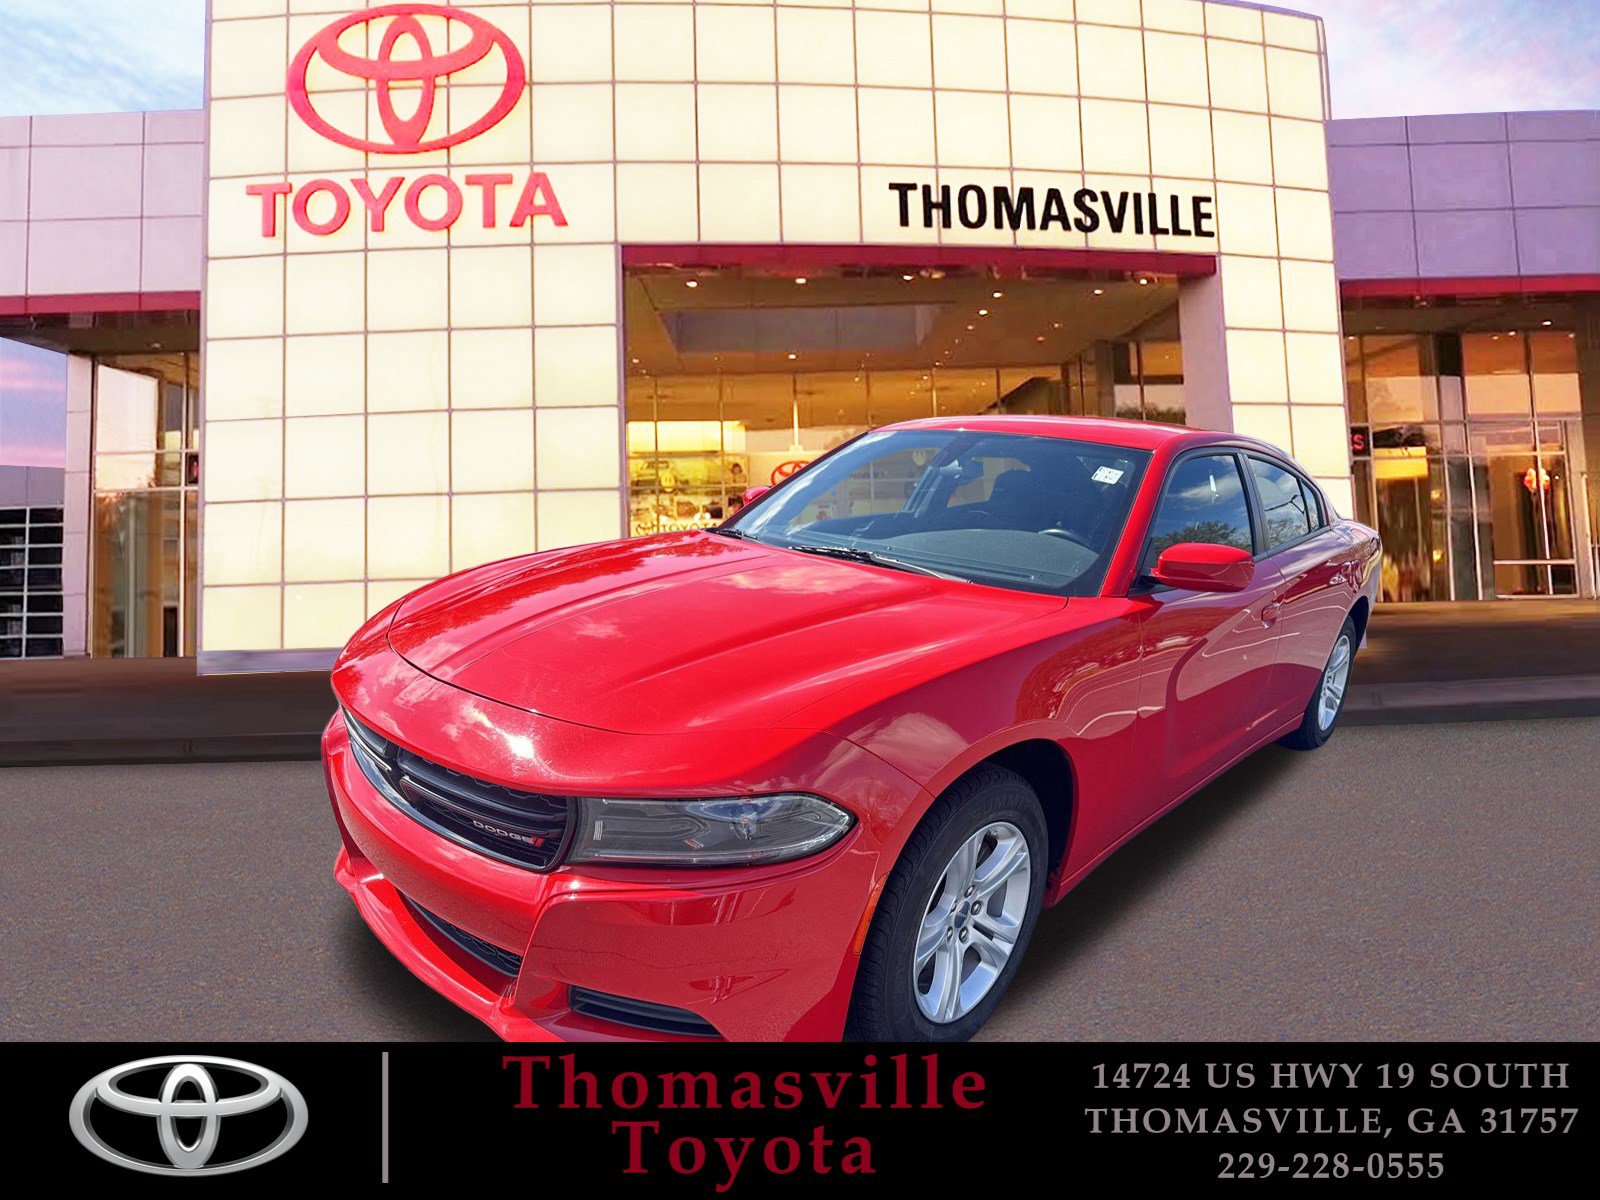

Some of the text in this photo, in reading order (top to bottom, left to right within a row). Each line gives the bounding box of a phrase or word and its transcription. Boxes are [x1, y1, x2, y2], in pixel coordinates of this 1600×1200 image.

[246, 172, 568, 237] TOYOTA
[889, 182, 1216, 238] THOMASVILLE
[472, 820, 535, 844] DODGE
